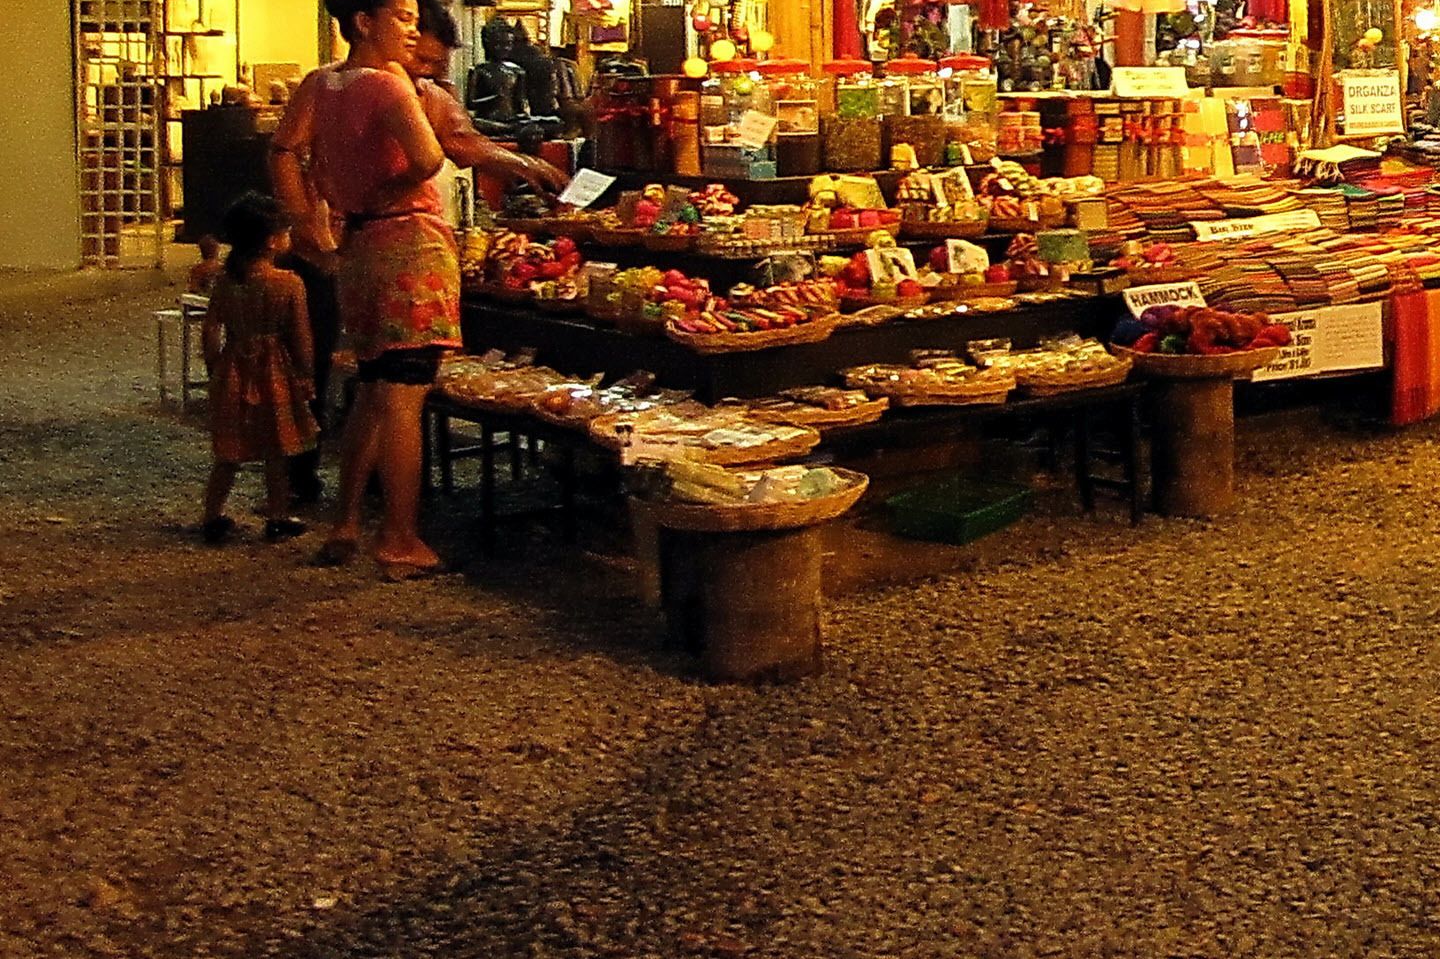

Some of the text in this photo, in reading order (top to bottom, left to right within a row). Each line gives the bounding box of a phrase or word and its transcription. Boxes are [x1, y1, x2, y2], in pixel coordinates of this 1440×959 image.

[1348, 84, 1397, 98] ORGANZA
[1350, 102, 1396, 115] SILK SCARF
[1129, 285, 1199, 308] HAMMOCK
